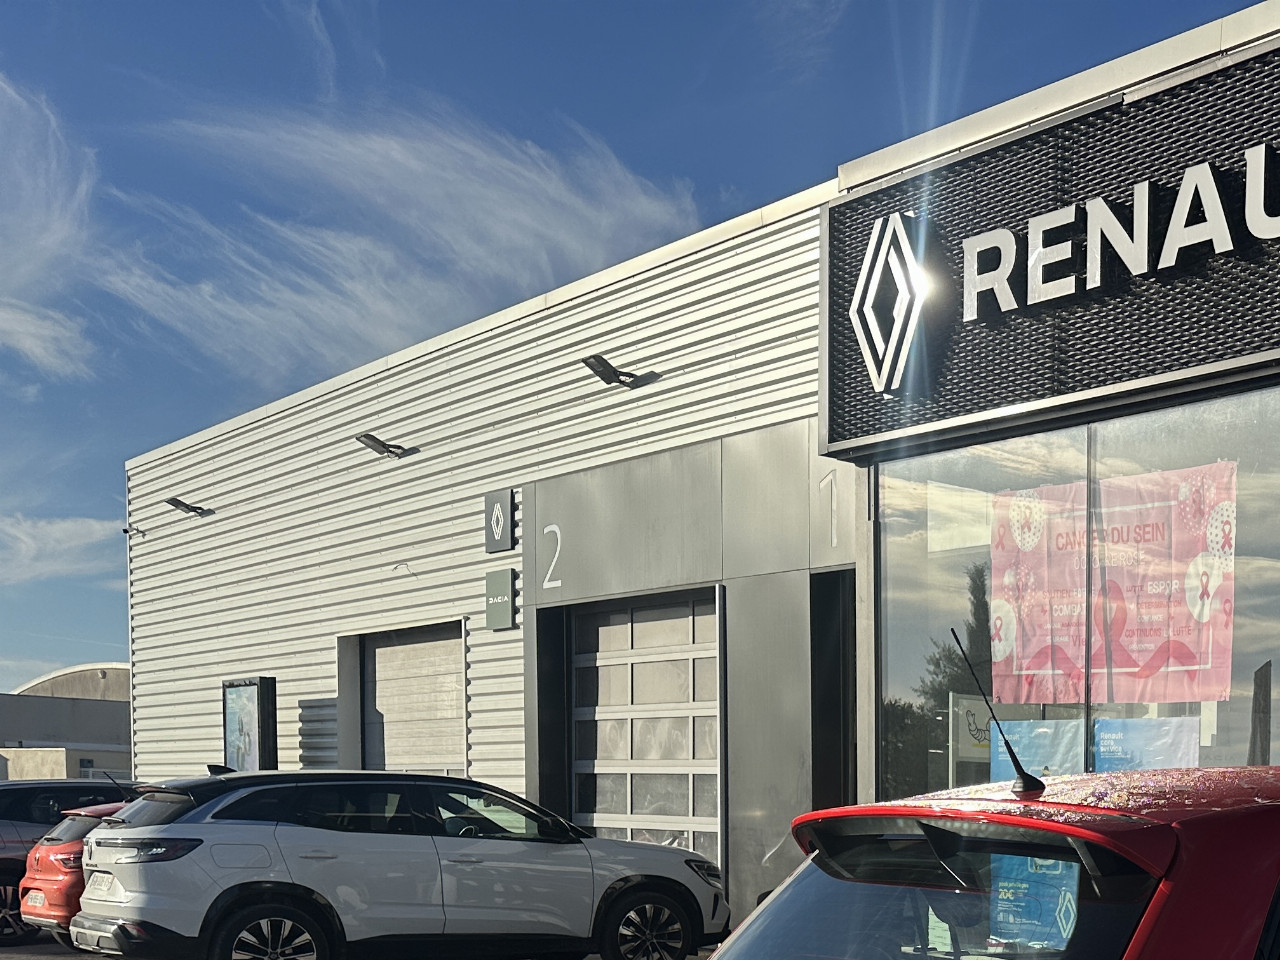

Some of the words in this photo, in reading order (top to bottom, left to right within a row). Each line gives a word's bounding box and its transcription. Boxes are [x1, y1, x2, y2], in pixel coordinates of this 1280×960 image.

[1056, 528, 1108, 551] CANCE
[1111, 525, 1130, 545] DU
[1133, 522, 1166, 544] SEIN
[543, 524, 562, 589] 2
[488, 595, 509, 604] DACIA
